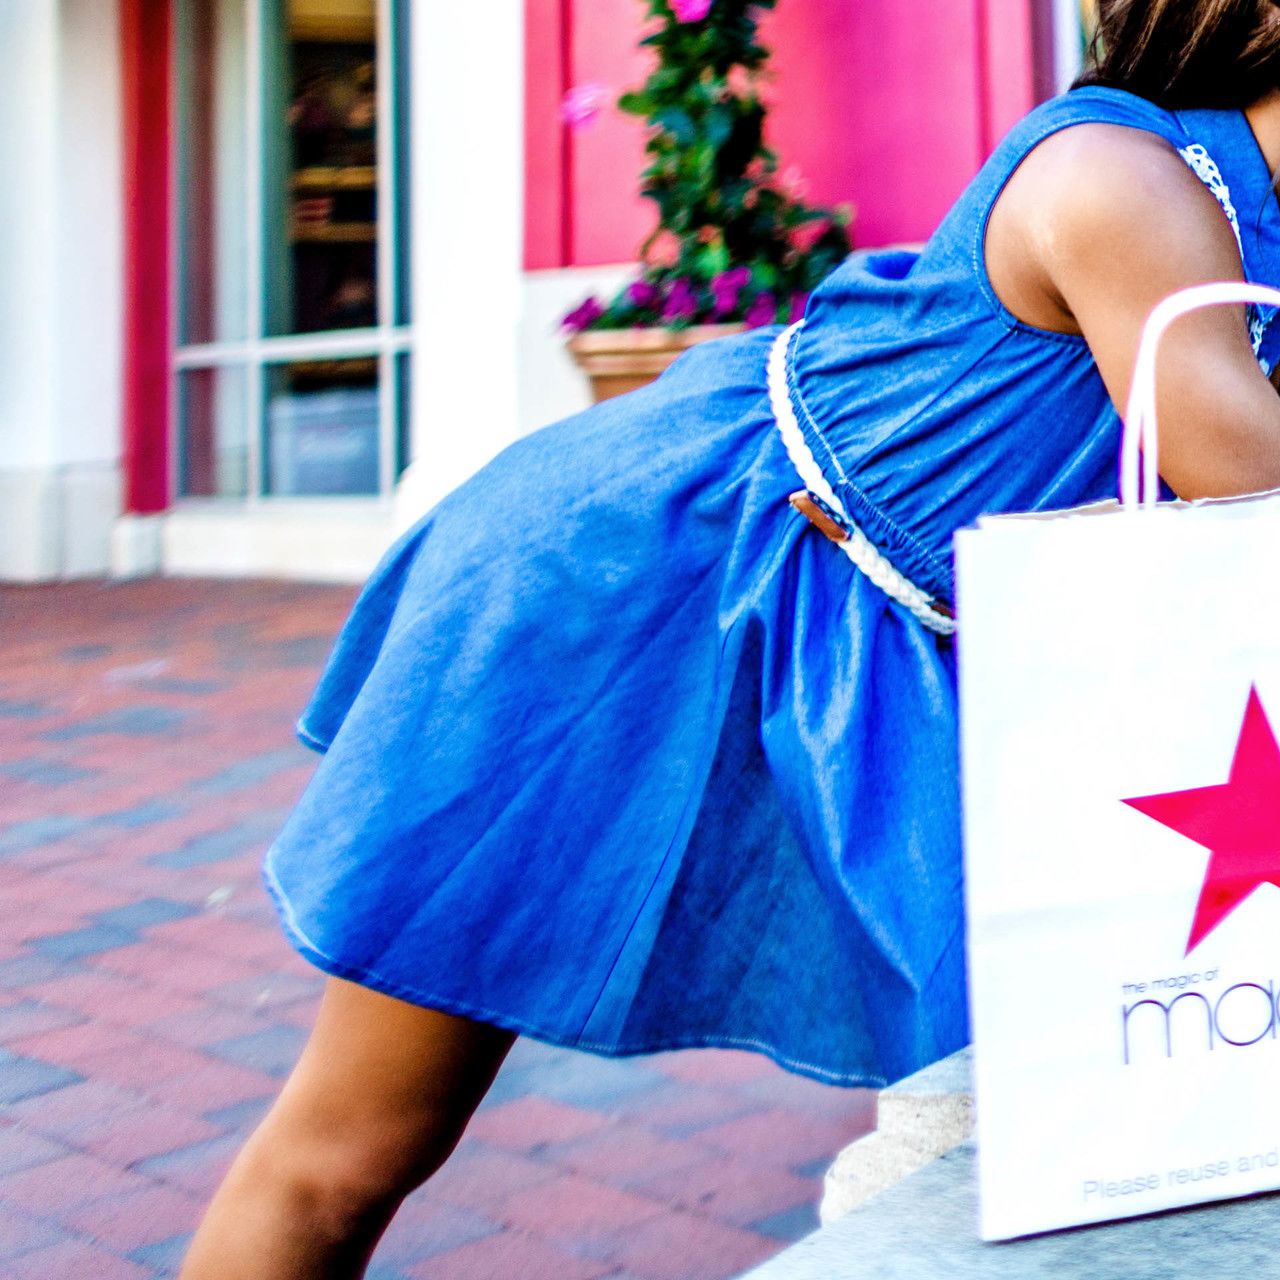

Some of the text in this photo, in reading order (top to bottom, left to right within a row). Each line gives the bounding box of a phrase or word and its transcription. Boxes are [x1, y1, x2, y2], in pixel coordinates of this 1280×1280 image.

[1152, 971, 1200, 989] magic
[1204, 967, 1219, 982] of
[1082, 1173, 1160, 1201] Please
[1167, 1161, 1229, 1186] reuse
[1237, 1148, 1280, 1173] and
